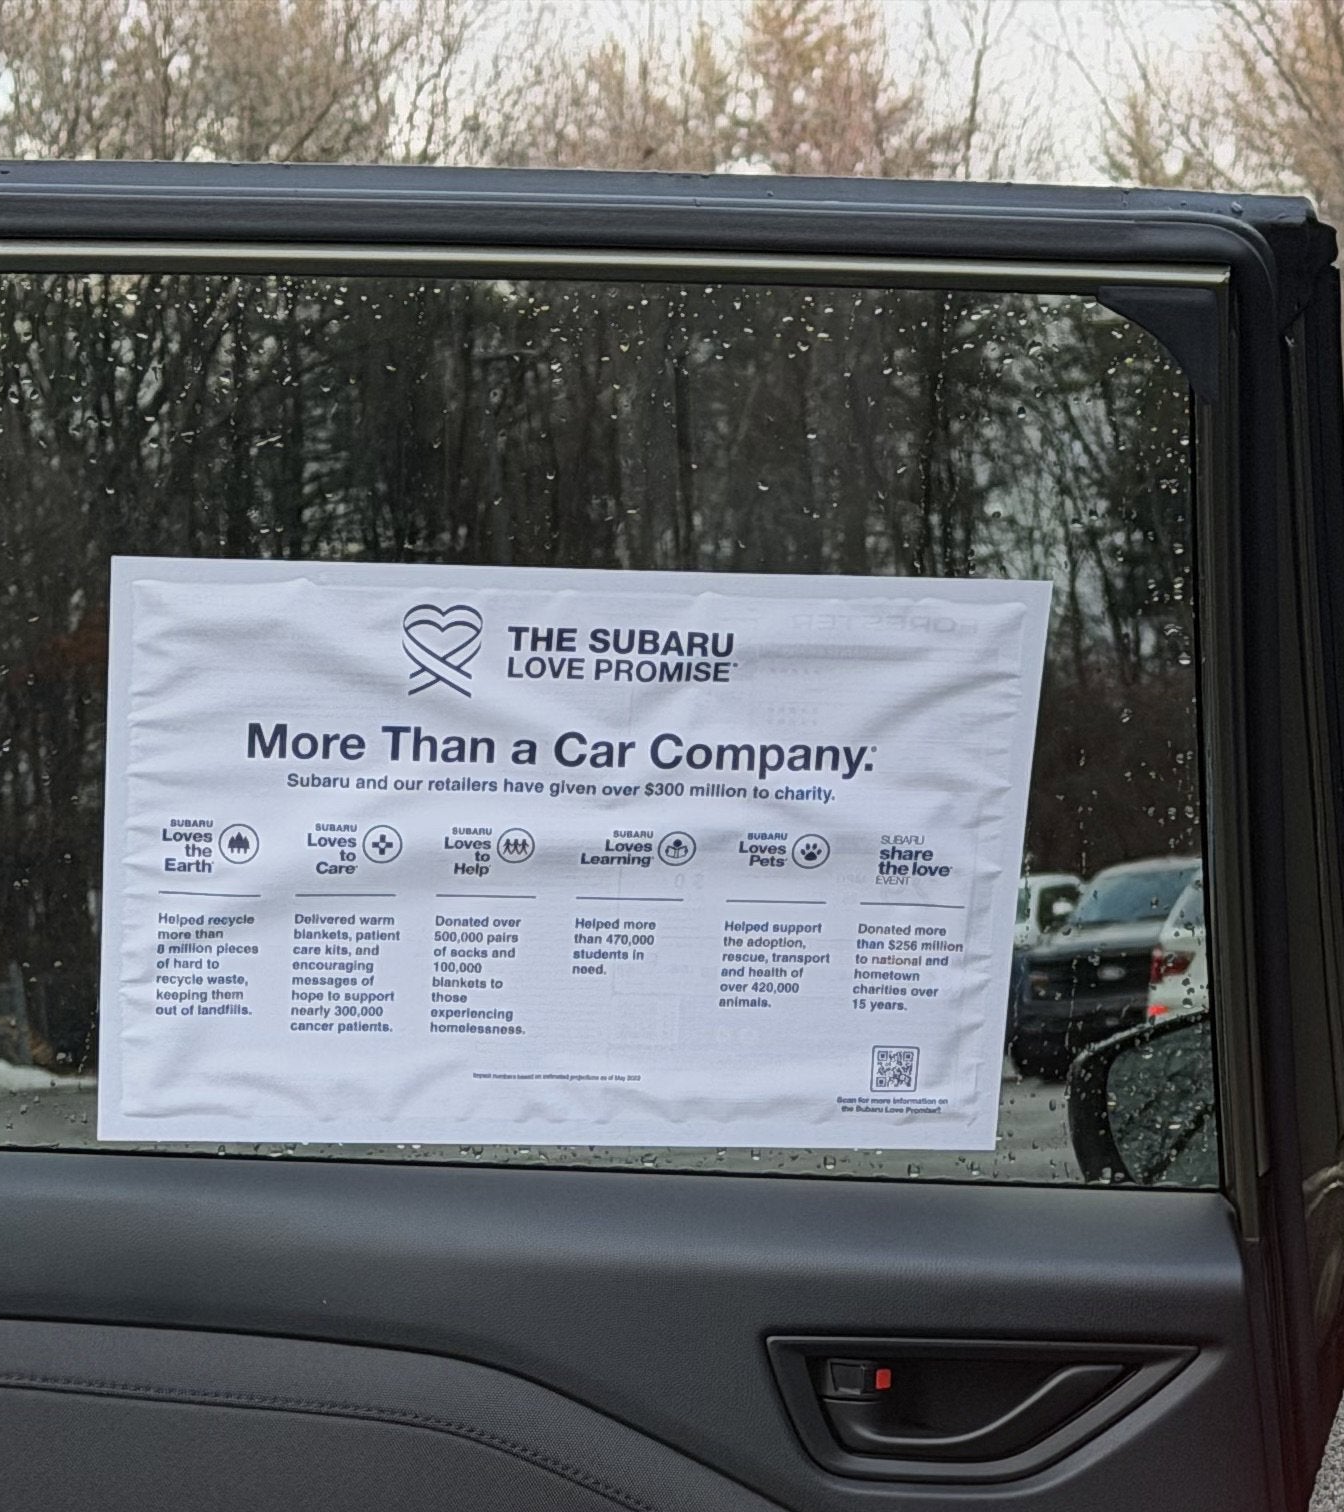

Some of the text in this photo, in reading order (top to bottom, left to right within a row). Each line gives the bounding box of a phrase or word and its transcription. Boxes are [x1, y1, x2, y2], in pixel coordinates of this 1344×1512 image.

[508, 626, 734, 657] THE SUBARU
[508, 657, 585, 679] LOVE
[248, 723, 365, 760] More
[382, 726, 494, 763] Than
[512, 740, 537, 764] a
[554, 732, 635, 768] Car
[287, 773, 835, 804] Subaru and our retailers have given over $300 million to charity.
[170, 819, 213, 827] SUBARU
[315, 823, 357, 832] SUBARU
[162, 828, 212, 843] Loves
[452, 827, 492, 835] SUBARU
[613, 830, 653, 838] SUBARU
[307, 833, 357, 848] Loves
[444, 836, 491, 849] Loves
[605, 839, 652, 852] Loves
[881, 835, 924, 844] SUBARU
[185, 844, 212, 857] the
[739, 841, 786, 855] Loves
[880, 846, 933, 861] share
[340, 850, 356, 862] to
[475, 851, 490, 862] to
[581, 852, 654, 868] Learning
[749, 855, 787, 867] Pets
[165, 858, 212, 873] Earth
[316, 861, 358, 874] Care
[454, 863, 489, 877] Help
[878, 861, 953, 877] the love
[876, 876, 908, 885] EVENT
[158, 913, 255, 927] Helped recycle
[295, 914, 394, 925] Delivered warm
[435, 915, 521, 927] Donated over
[575, 918, 656, 931] Helped more
[158, 929, 223, 940] more than
[725, 921, 822, 935] Helped support
[858, 923, 946, 936] Donated more
[294, 929, 400, 942] blankets, patient
[434, 931, 518, 945] 500,000 pairs
[574, 934, 654, 946] than 470,000
[169, 943, 212, 953] million
[217, 943, 258, 956] pieces
[724, 937, 806, 949] the adoption,
[857, 939, 963, 952] than $256 million
[293, 945, 379, 956] care kits, and
[434, 946, 515, 958] of socks and
[573, 949, 644, 960] students in
[157, 958, 219, 969] of hard to
[722, 953, 830, 965] rescue, transport
[856, 954, 949, 966] to national and
[292, 961, 374, 973] encouraging
[434, 962, 482, 973] 100,000
[572, 964, 606, 975] need.
[721, 966, 803, 978] and health of
[156, 974, 248, 987] recycle waste,
[292, 975, 374, 988] messages of
[854, 969, 920, 981] hometown
[432, 976, 503, 989] blankets to
[720, 982, 799, 994] over 420,000
[156, 989, 243, 1003] keeping them
[292, 990, 394, 1003] hope to support
[853, 984, 939, 997] charities over
[432, 992, 467, 1003] those
[719, 997, 771, 1007] animals.
[155, 1004, 252, 1015] out of landfills.
[291, 1005, 383, 1018] nearly 300,000
[853, 999, 907, 1012] 15 years.
[431, 1008, 513, 1022] experiencing
[290, 1022, 393, 1034] cancer patients.
[430, 1022, 525, 1034] homelessness.
